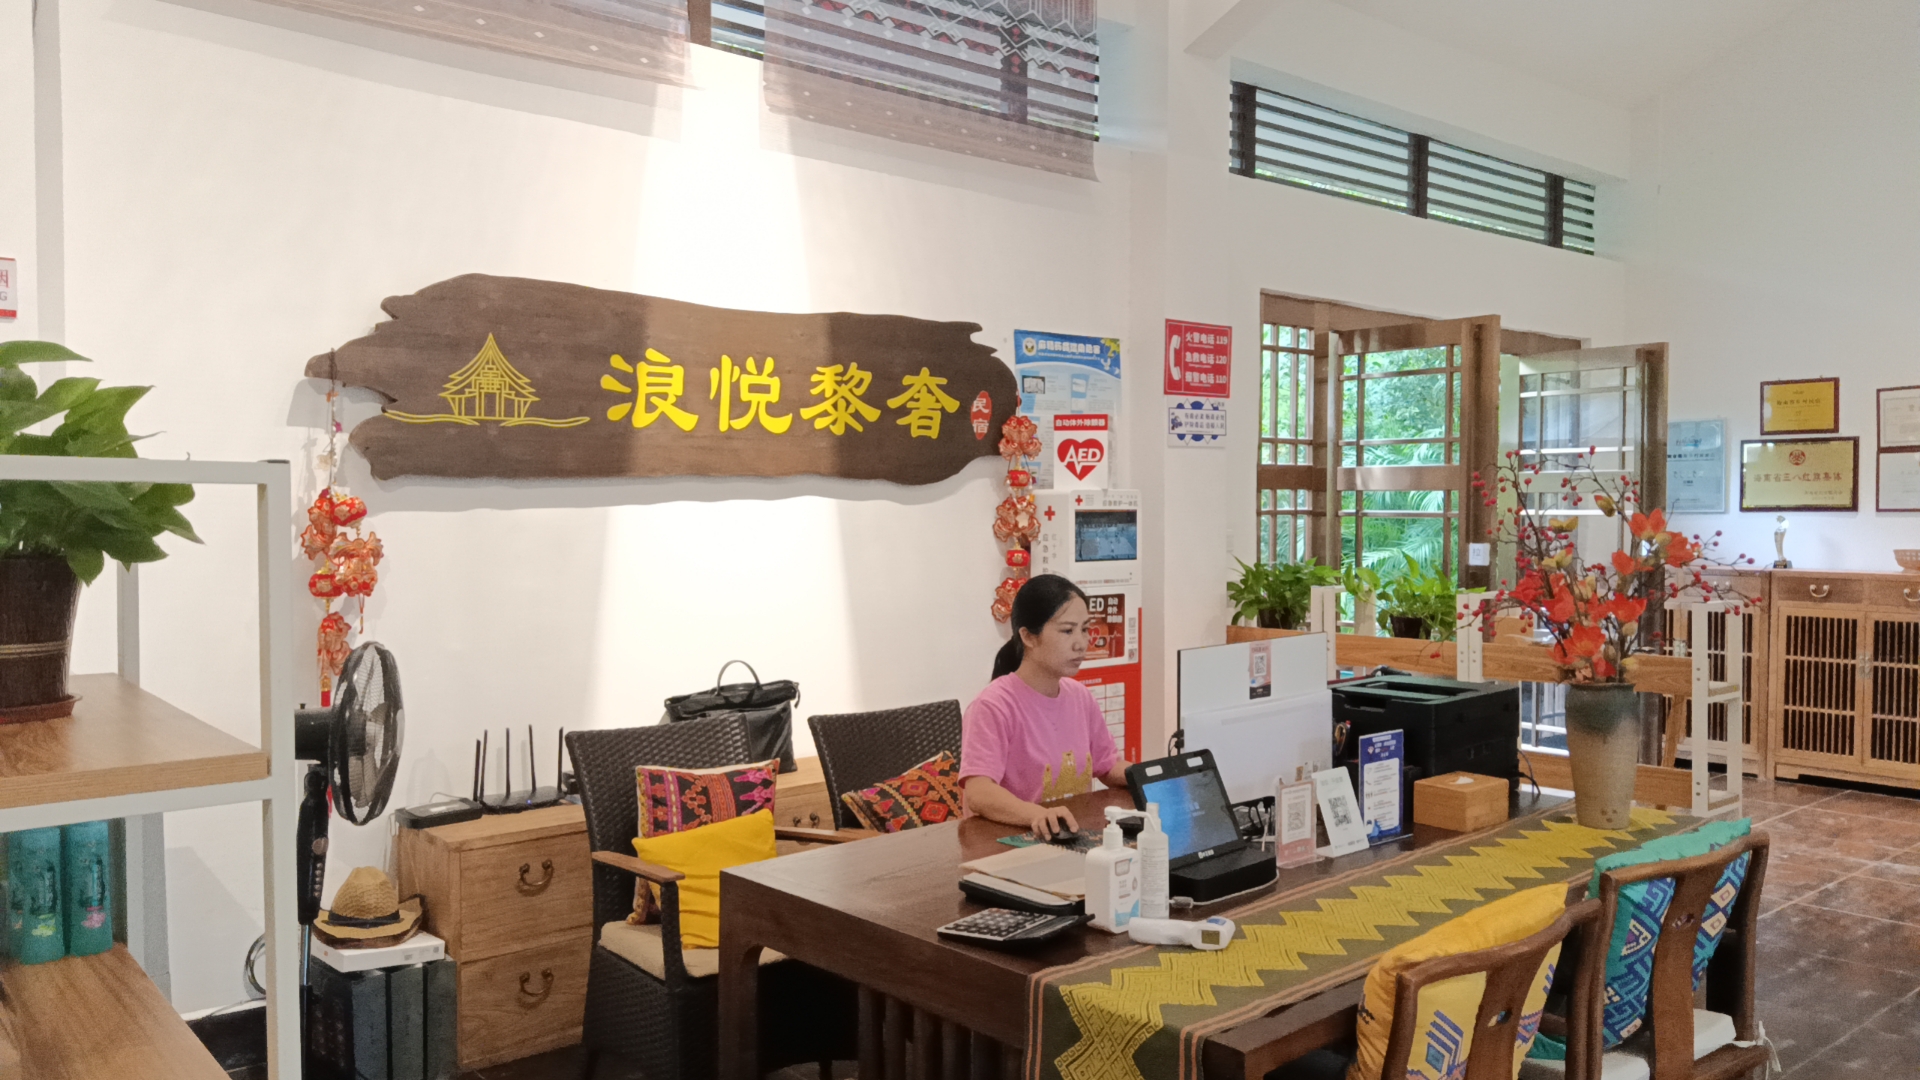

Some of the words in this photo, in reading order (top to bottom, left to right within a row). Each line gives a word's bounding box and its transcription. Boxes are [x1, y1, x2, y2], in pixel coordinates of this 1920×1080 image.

[1185, 332, 1215, 345] 火警电话
[1216, 335, 1228, 345] 119
[1185, 351, 1215, 365] 急救电话
[1215, 355, 1228, 365] 120
[1215, 375, 1227, 384] 110
[600, 347, 961, 440] 浪悦黎奢
[972, 397, 990, 434] 民宿
[1064, 444, 1101, 468] AED
[1753, 472, 1842, 483] 海南省三八红旗集体
[1089, 597, 1105, 612] ED
